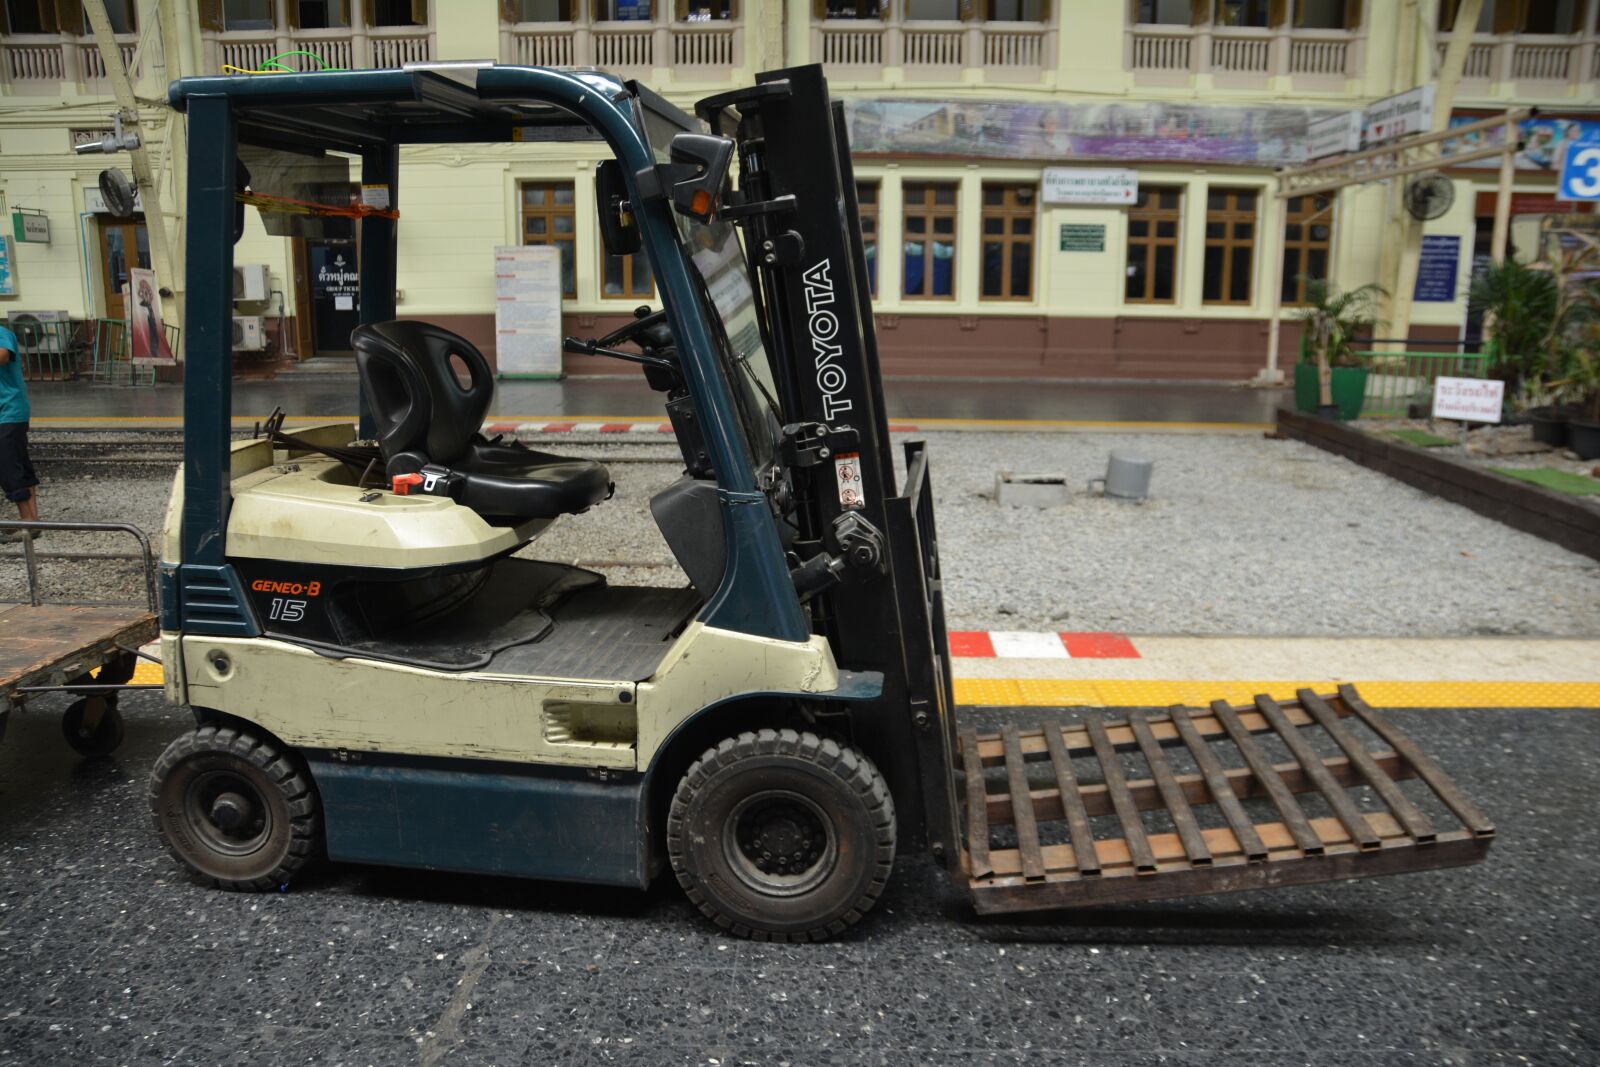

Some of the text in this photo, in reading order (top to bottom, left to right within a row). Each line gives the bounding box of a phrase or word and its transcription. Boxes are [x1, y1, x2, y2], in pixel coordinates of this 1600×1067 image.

[1569, 148, 1600, 197] 3
[803, 258, 852, 420] TOYOTA
[269, 597, 307, 622] 15
